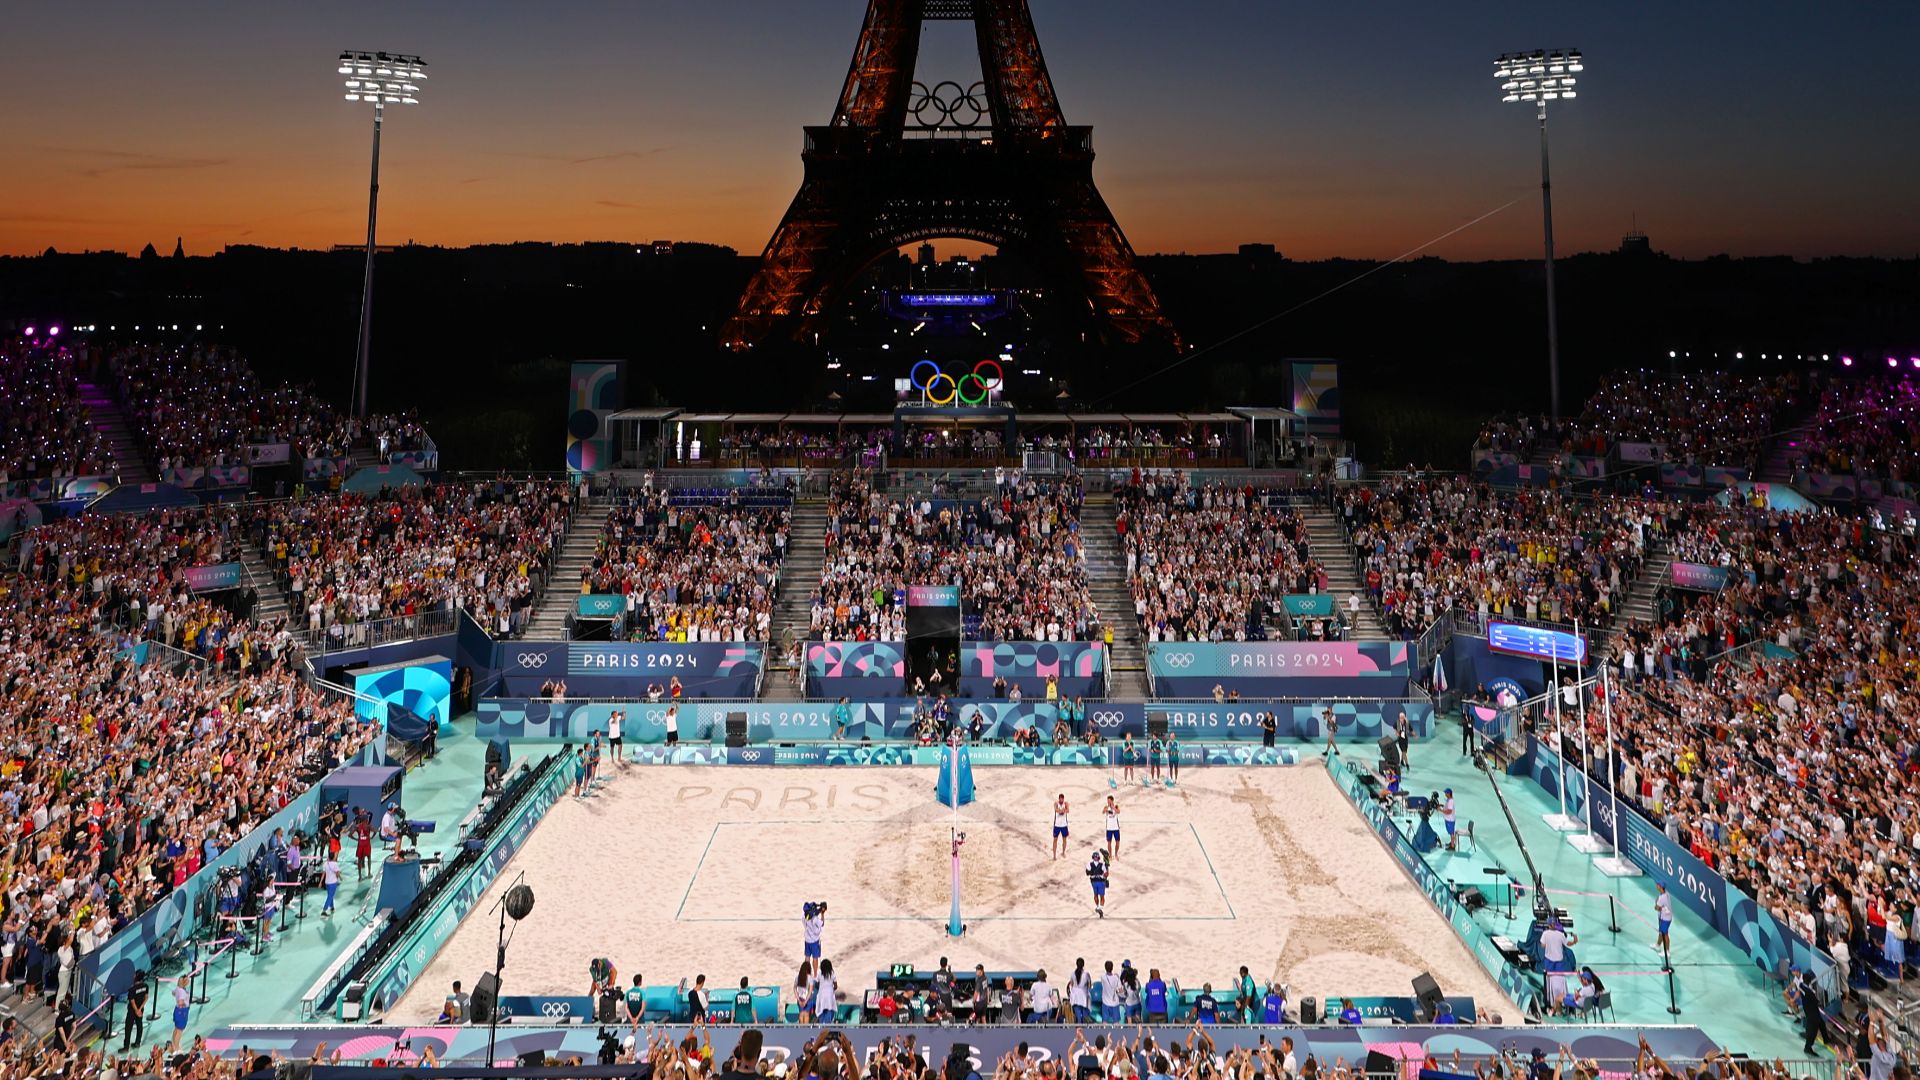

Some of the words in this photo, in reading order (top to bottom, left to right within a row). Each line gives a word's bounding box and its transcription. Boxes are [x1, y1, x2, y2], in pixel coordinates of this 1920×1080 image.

[647, 654, 698, 668] 2024
[1293, 653, 1343, 668] 2024
[779, 712, 831, 727] 2024
[1167, 711, 1218, 728] ARIS
[675, 784, 890, 812] PARIS
[1678, 865, 1716, 911] 2024
[1367, 1006, 1395, 1016] 2024
